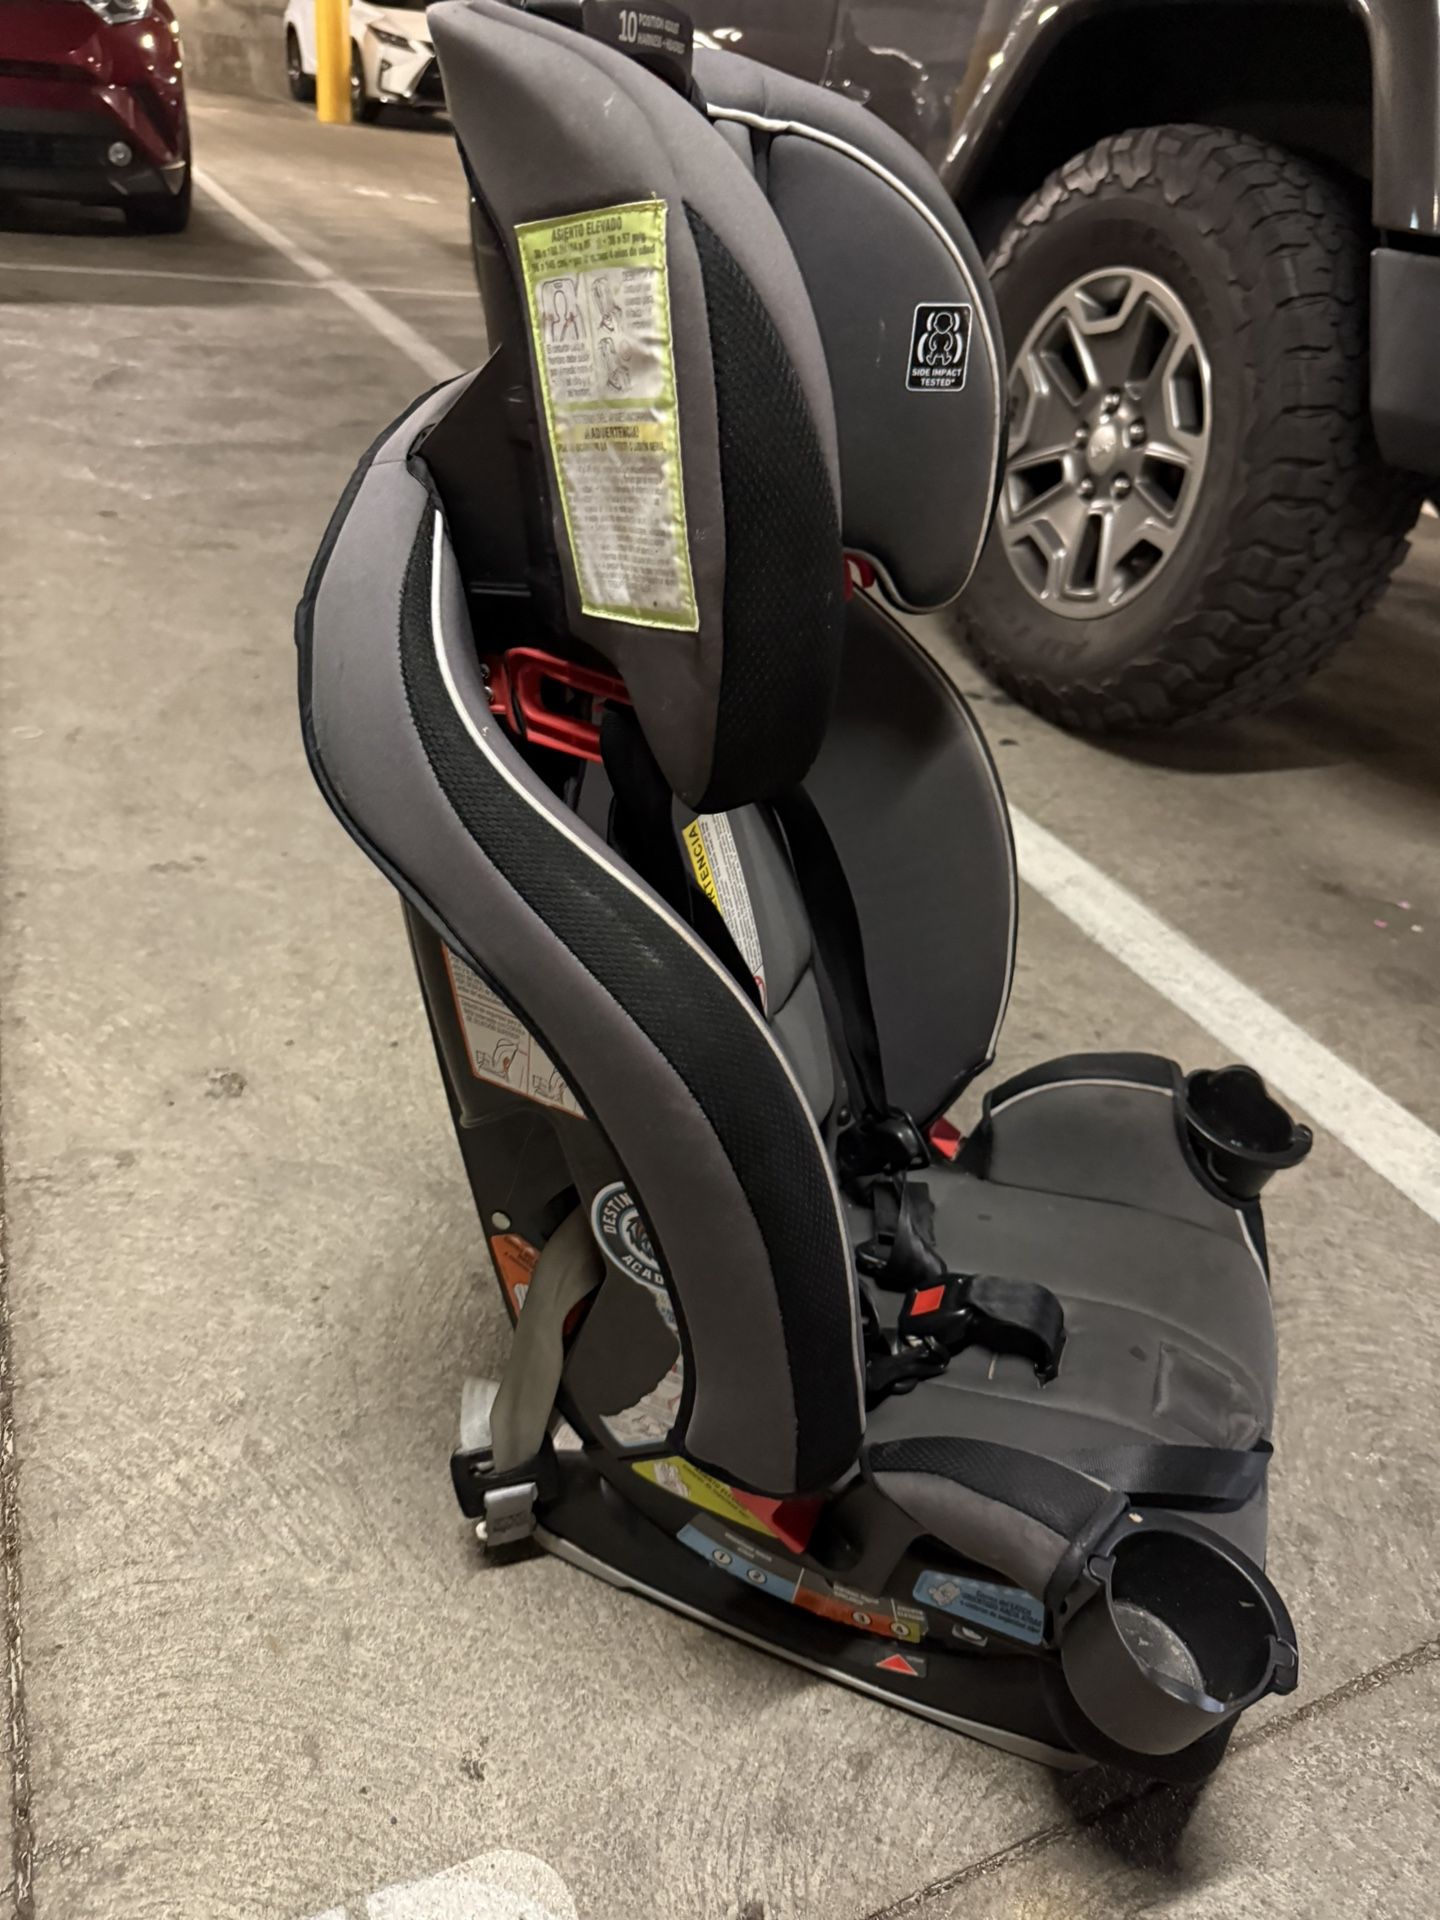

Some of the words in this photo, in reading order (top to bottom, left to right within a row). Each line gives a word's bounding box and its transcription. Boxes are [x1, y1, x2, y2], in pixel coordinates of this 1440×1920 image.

[619, 9, 638, 43] 10
[552, 224, 584, 242] ASIENTO
[586, 216, 622, 236] ELEVADO
[912, 368, 930, 376] SIDE
[932, 368, 962, 376] IMPACT
[688, 825, 717, 905] RTENCIA
